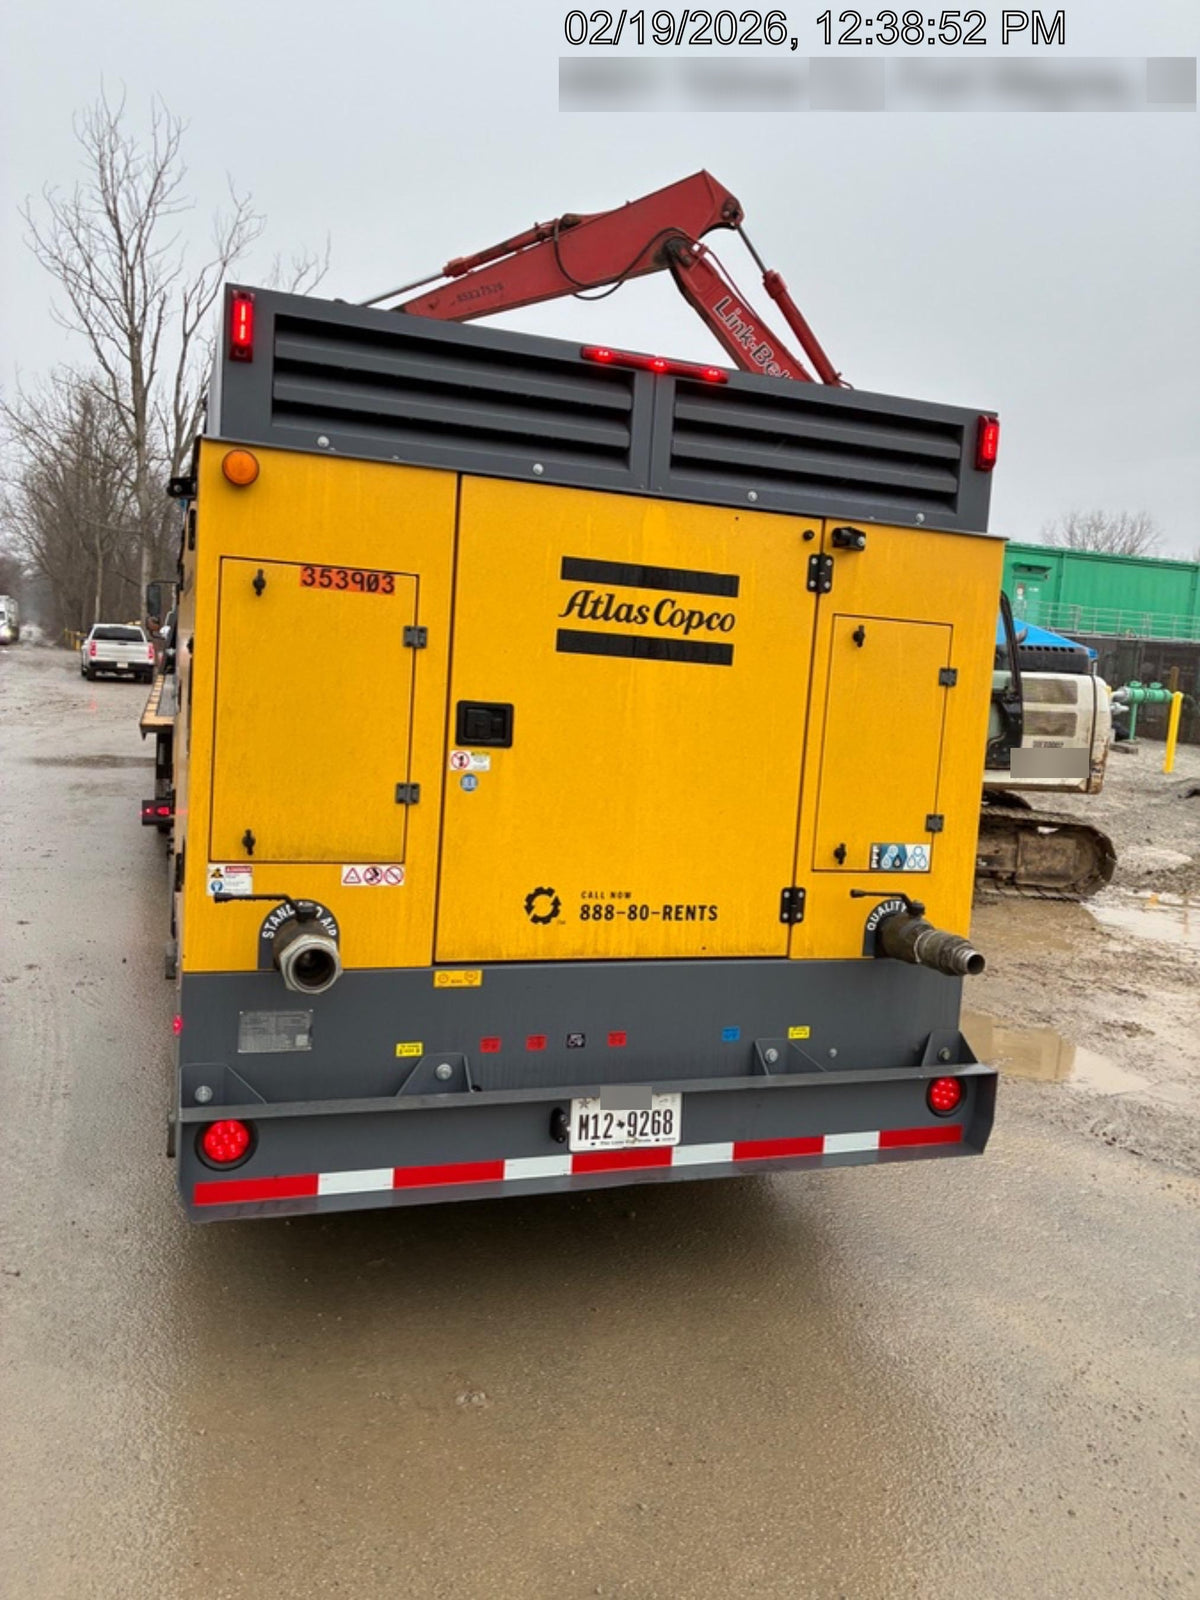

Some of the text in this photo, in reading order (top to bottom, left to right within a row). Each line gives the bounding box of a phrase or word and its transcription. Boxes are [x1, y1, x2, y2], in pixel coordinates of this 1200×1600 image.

[301, 566, 395, 594] 353903
[558, 589, 735, 635] Atlas Copco
[581, 891, 632, 899] CALL NOW
[579, 904, 719, 922] 888-80-RENTS
[867, 900, 907, 931] QUALITY
